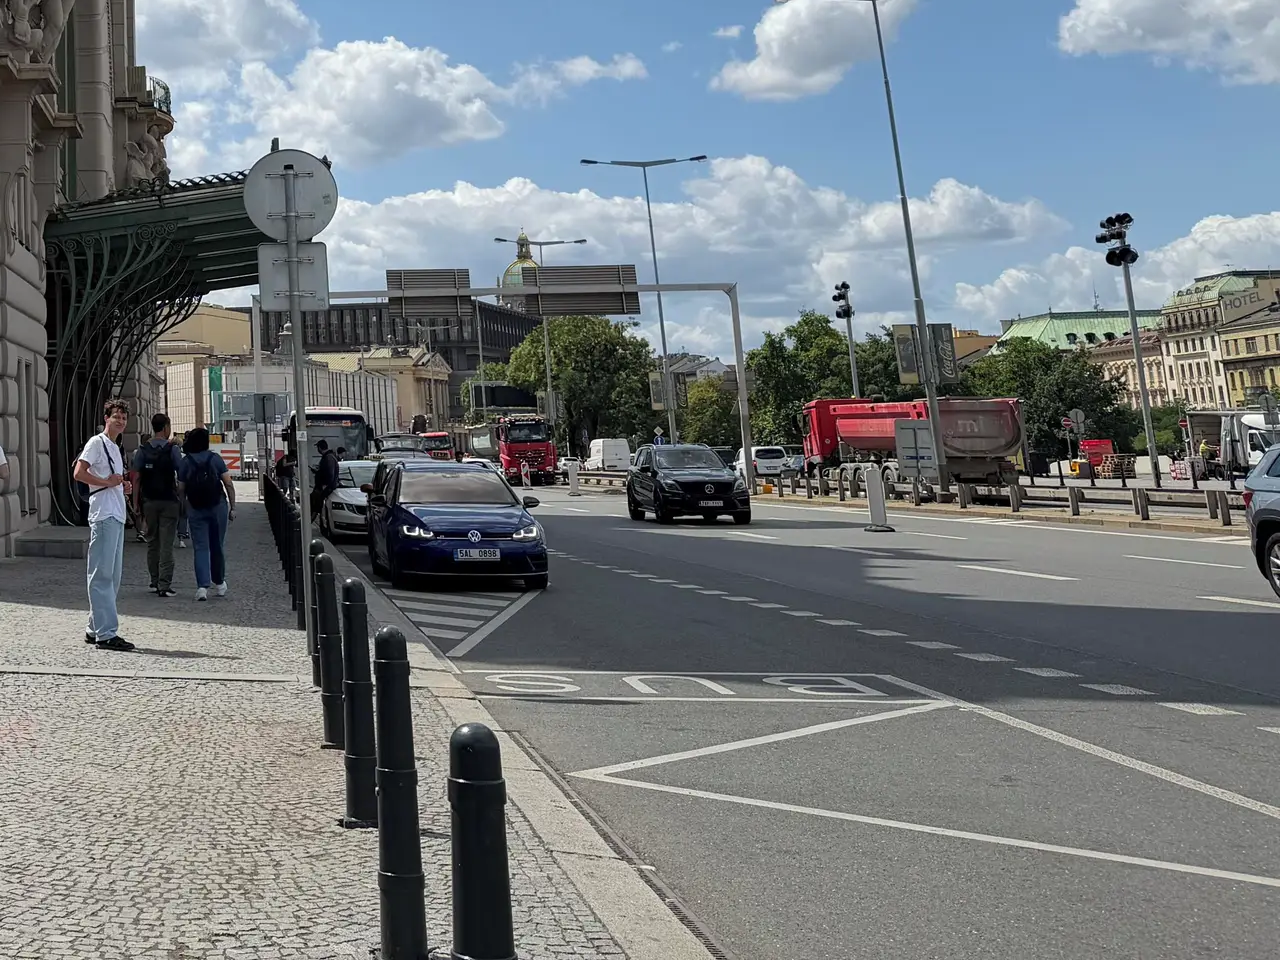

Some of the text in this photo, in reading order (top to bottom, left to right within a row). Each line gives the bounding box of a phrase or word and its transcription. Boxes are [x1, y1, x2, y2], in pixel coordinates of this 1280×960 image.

[1224, 291, 1265, 310] HOTEL
[459, 549, 473, 558] 5AL
[484, 673, 889, 697] BUS
